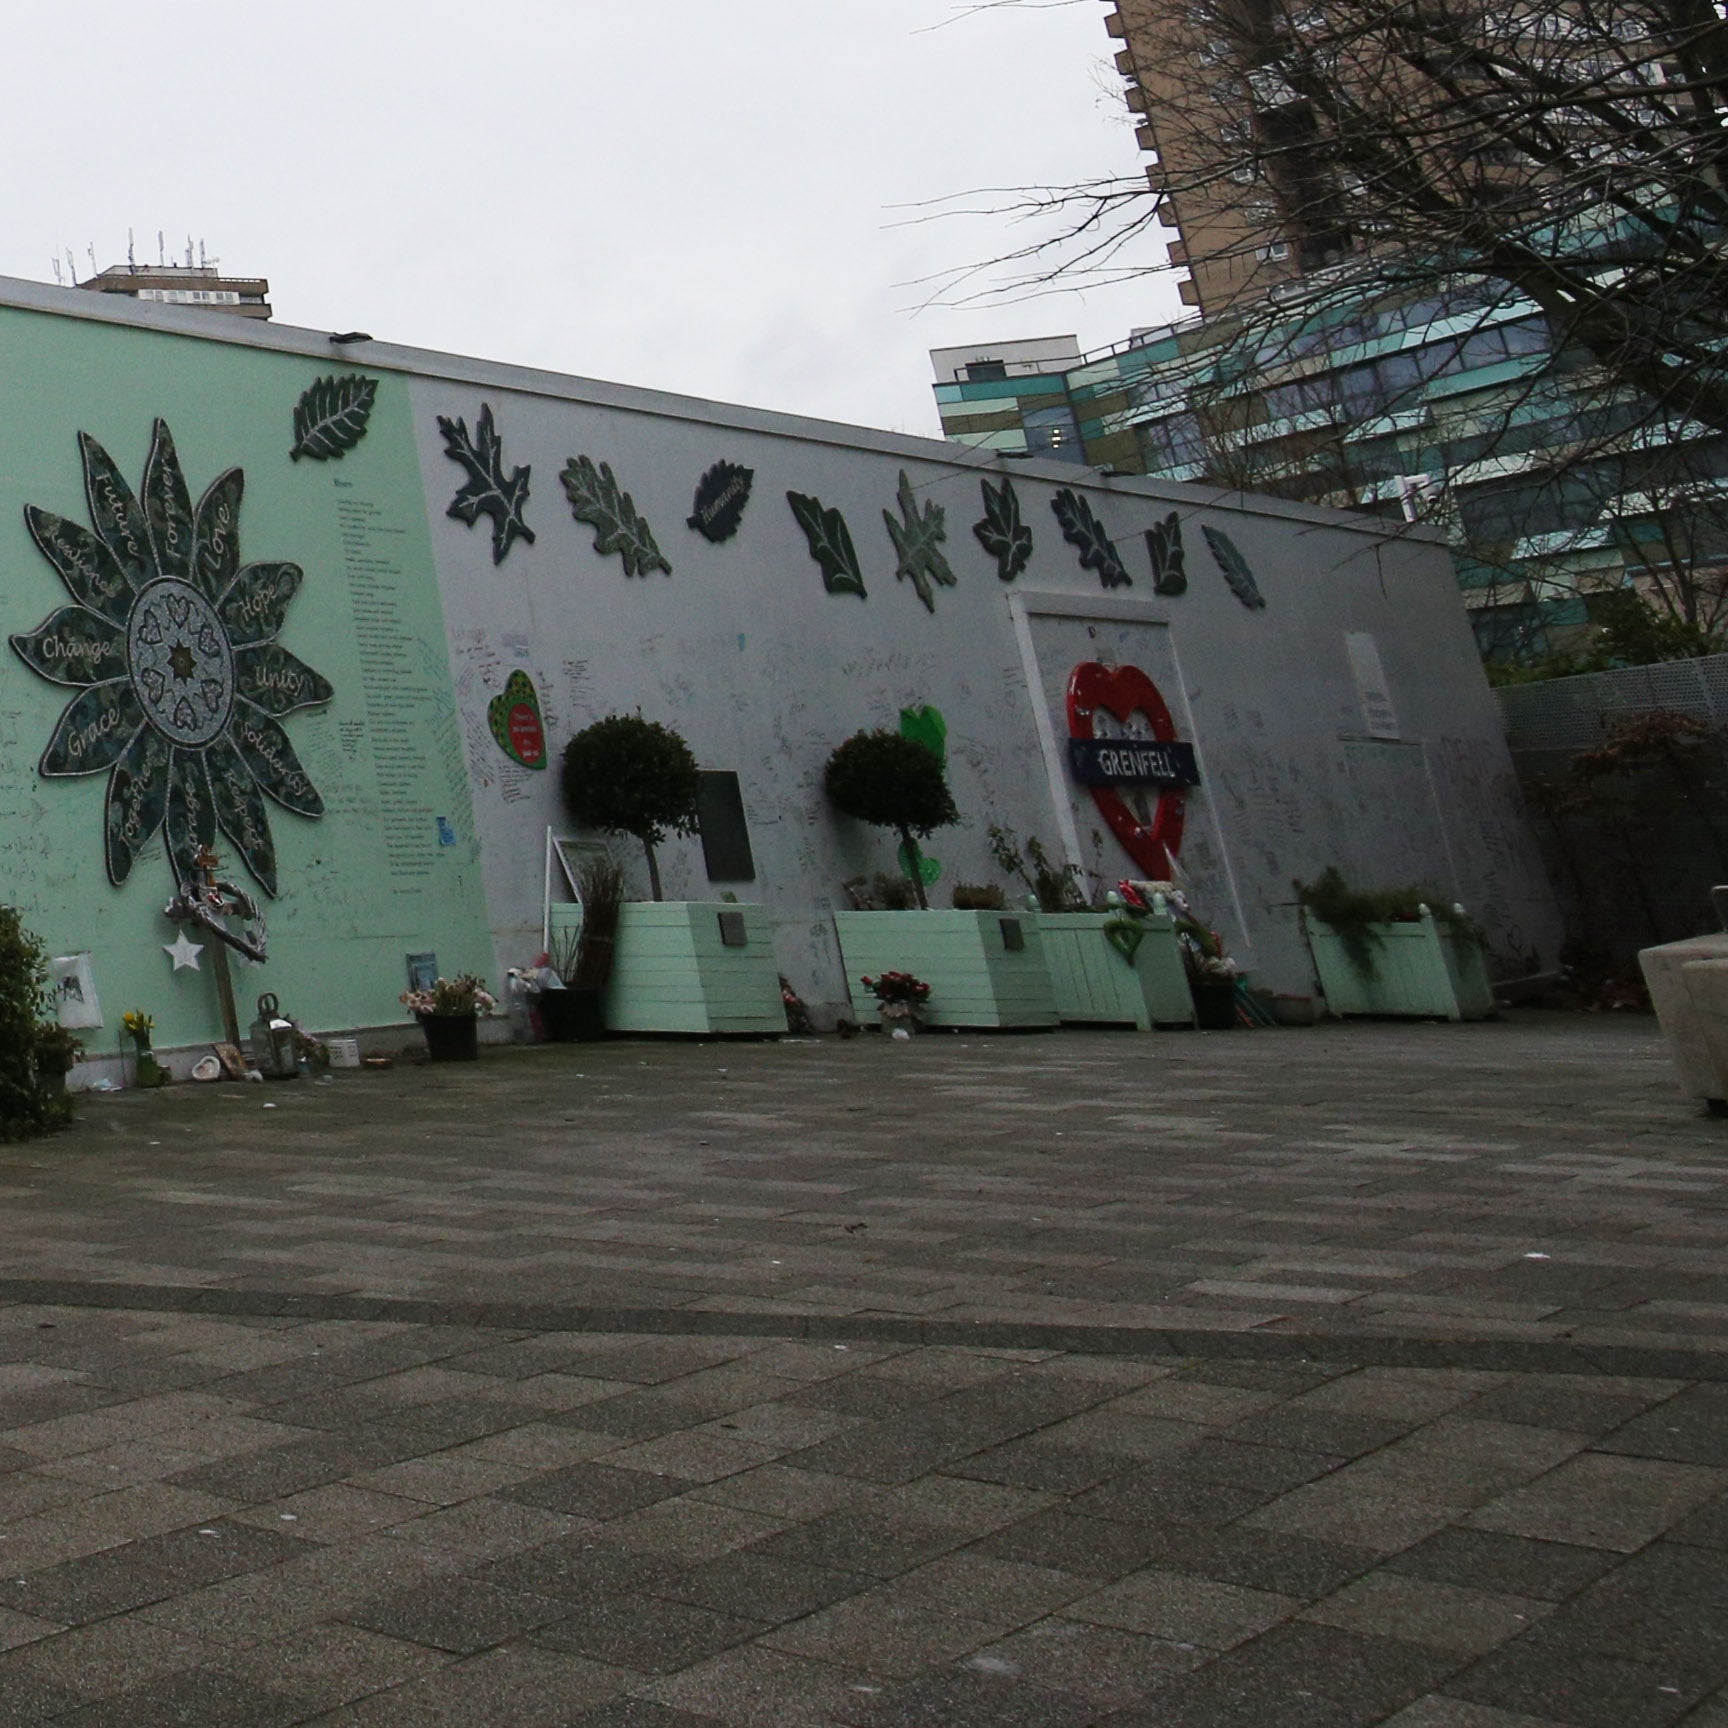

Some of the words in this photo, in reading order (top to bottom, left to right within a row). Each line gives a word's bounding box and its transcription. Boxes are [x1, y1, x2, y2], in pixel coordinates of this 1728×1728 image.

[94, 472, 140, 556] Future
[160, 457, 183, 558] Forever
[204, 501, 232, 571] Love
[238, 583, 278, 622] Hope
[42, 636, 113, 665] Change
[254, 665, 305, 698] Unity
[66, 705, 121, 758] Grace
[240, 721, 305, 799] Solidarity
[1097, 748, 1176, 777] GRENFELL
